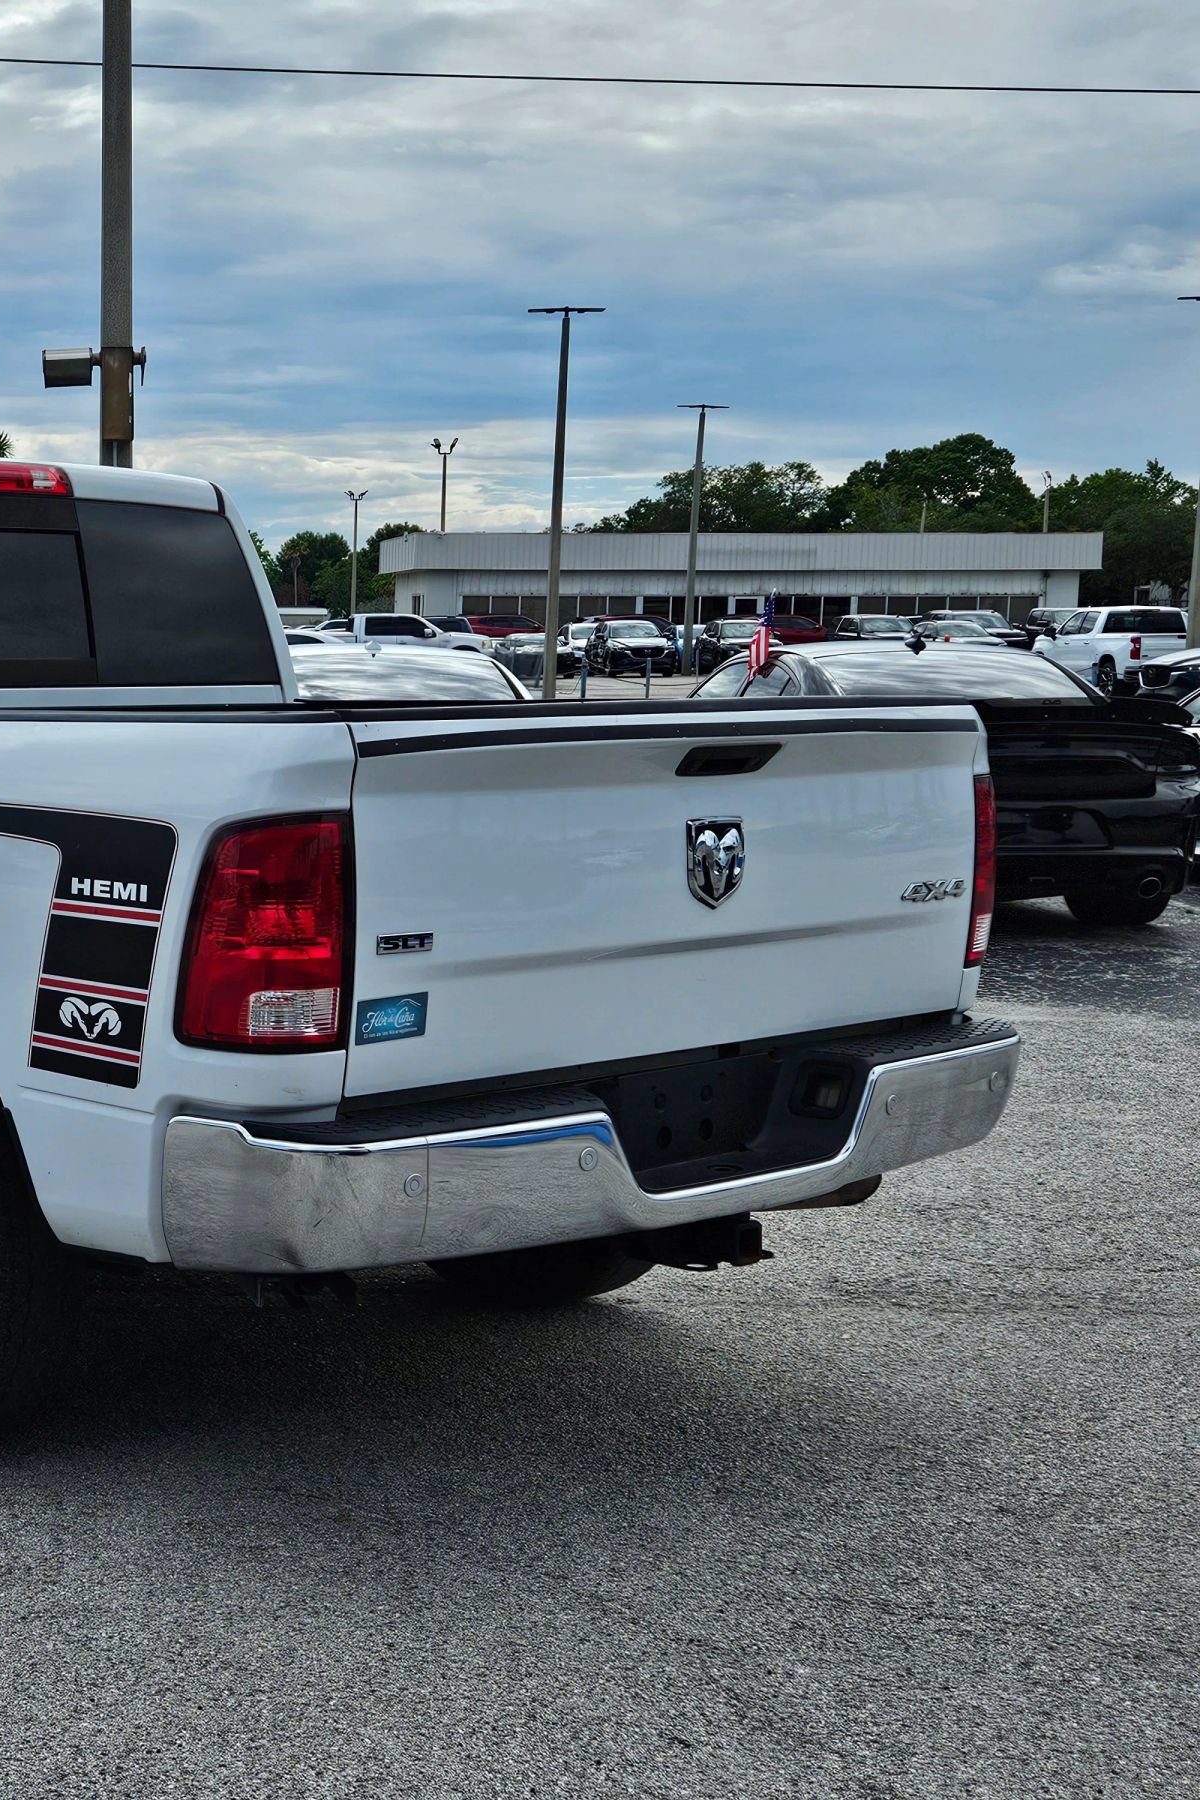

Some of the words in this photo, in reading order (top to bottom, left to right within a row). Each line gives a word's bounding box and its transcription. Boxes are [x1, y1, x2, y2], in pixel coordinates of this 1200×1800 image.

[71, 877, 148, 902] HEMI
[379, 934, 431, 951] SLT
[362, 1011, 388, 1033] Flor
[394, 1006, 415, 1028] Caña
